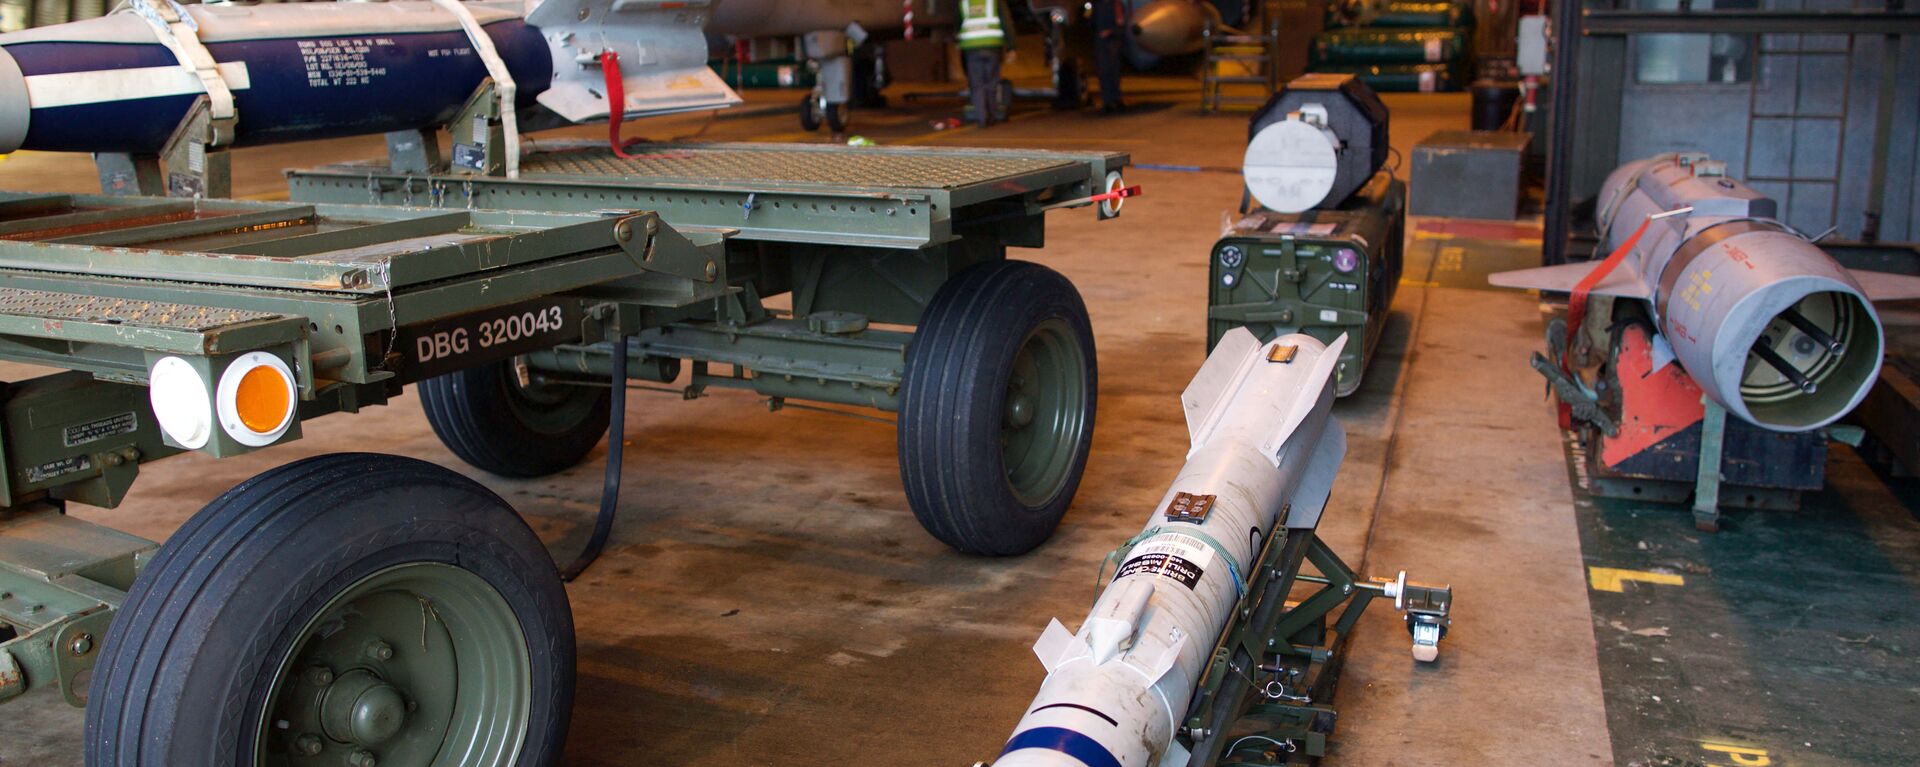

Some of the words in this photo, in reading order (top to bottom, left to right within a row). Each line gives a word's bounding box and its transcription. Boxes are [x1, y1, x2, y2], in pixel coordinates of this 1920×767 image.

[427, 49, 439, 57] NOT
[454, 48, 470, 56] FLIGHT
[306, 62, 319, 71] LOT
[308, 78, 329, 87] TOTAL
[332, 77, 342, 86] WT
[416, 327, 470, 363] DBG
[478, 305, 564, 348] 320043
[1120, 559, 1163, 573] MISSILE
[1166, 562, 1196, 579] DRILL
